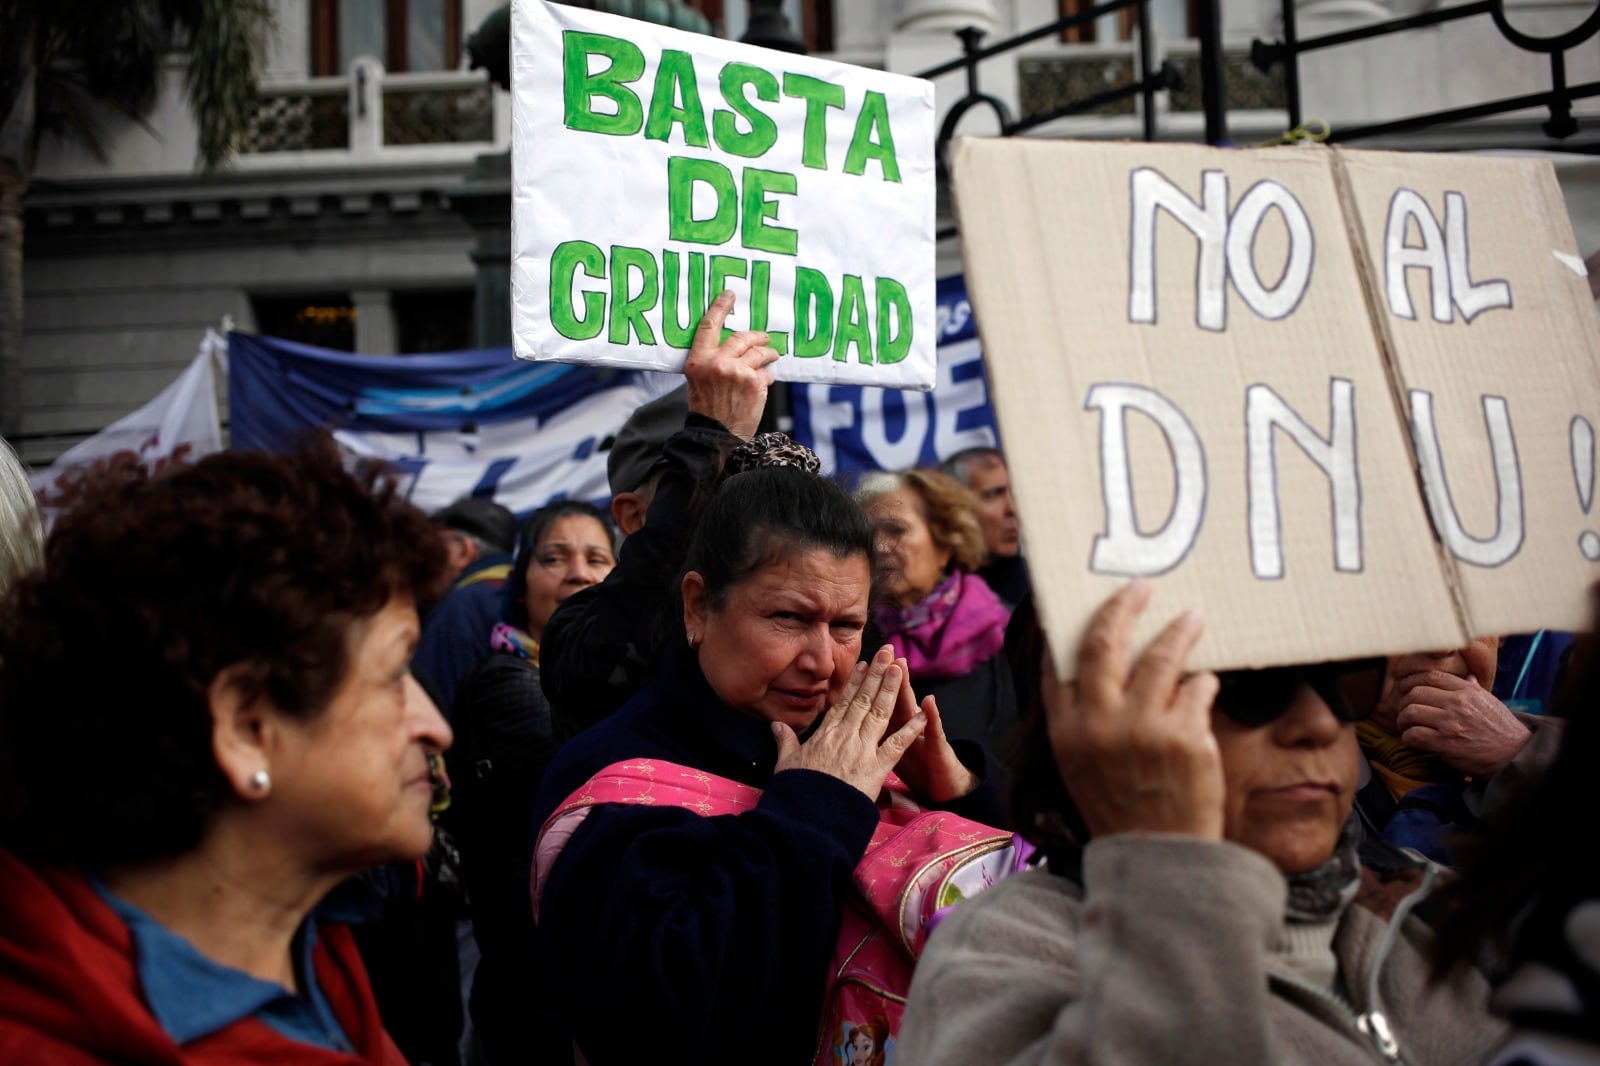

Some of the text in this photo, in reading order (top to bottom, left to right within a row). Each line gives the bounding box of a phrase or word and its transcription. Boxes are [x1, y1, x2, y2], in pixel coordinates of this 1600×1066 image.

[562, 30, 902, 184] BASTA
[668, 156, 798, 256] DE
[1128, 166, 1513, 332] NO AL
[1084, 376, 1600, 579] DNU!
